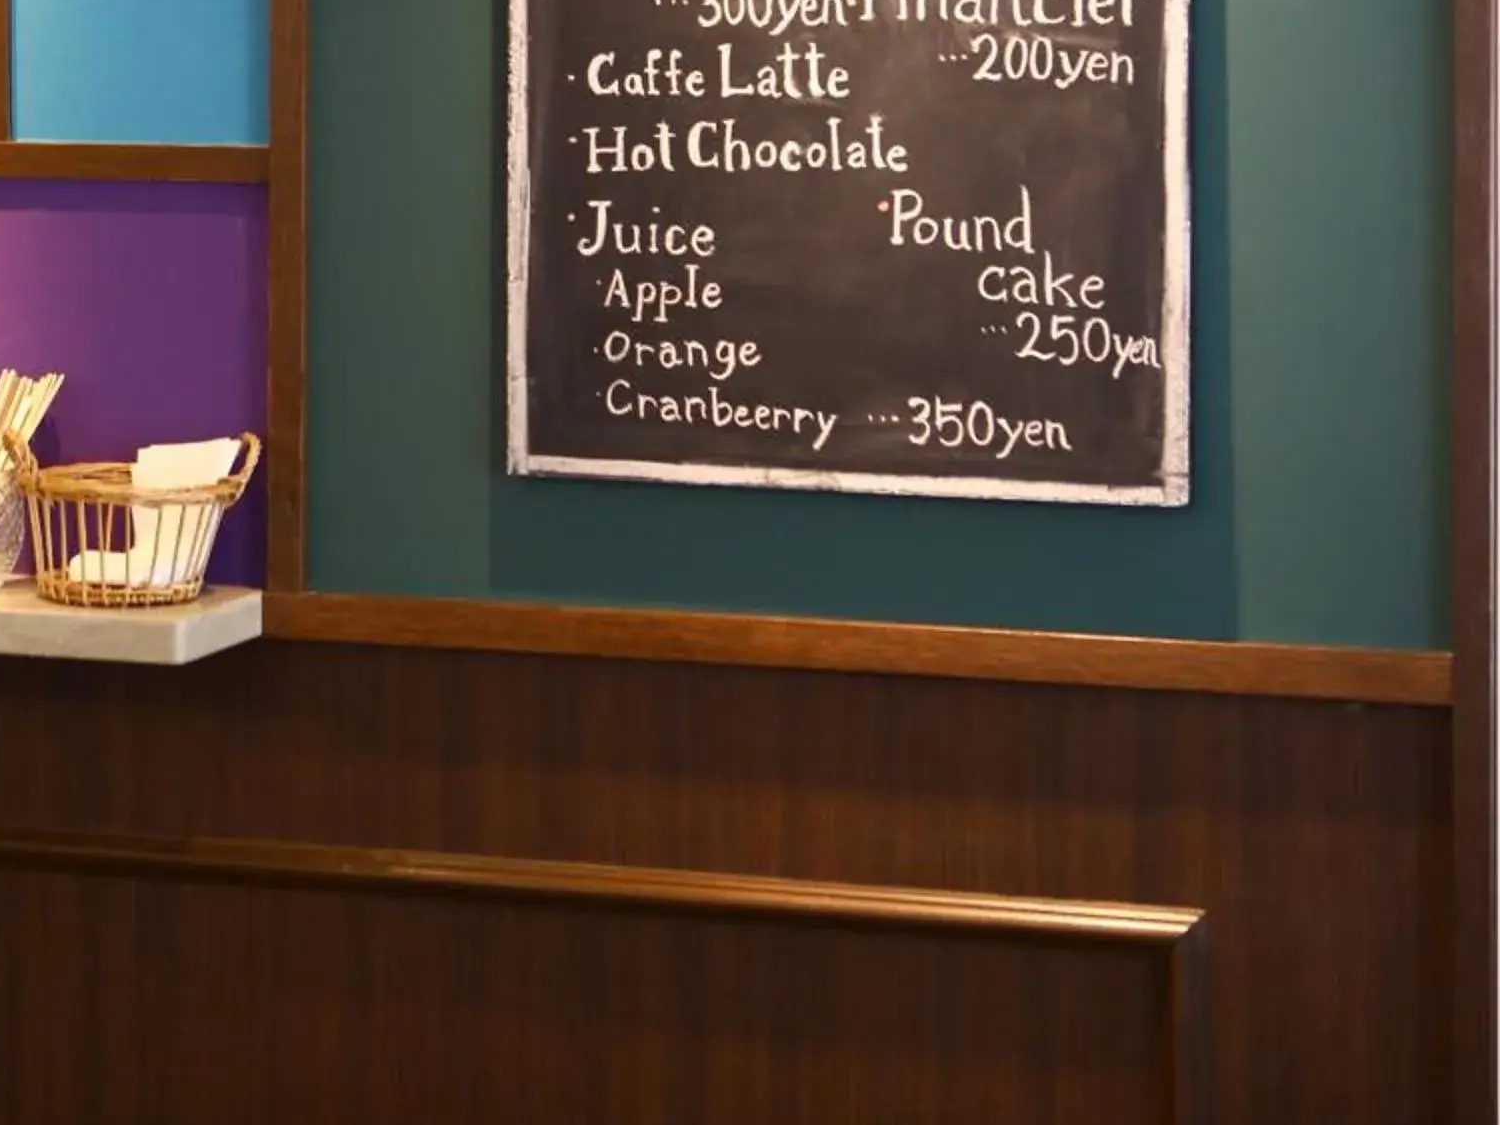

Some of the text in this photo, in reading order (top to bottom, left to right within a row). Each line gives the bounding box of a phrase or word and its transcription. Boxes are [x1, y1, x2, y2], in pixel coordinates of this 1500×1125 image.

[587, 42, 850, 99] Caffe Latte
[583, 115, 908, 173] Hot Chocolate
[577, 200, 715, 257] Juice
[890, 186, 1035, 254] Pound
[604, 264, 722, 323] Apple
[978, 248, 1104, 309] cake
[604, 330, 761, 380] Orange
[606, 380, 837, 451] Cranbeerry
